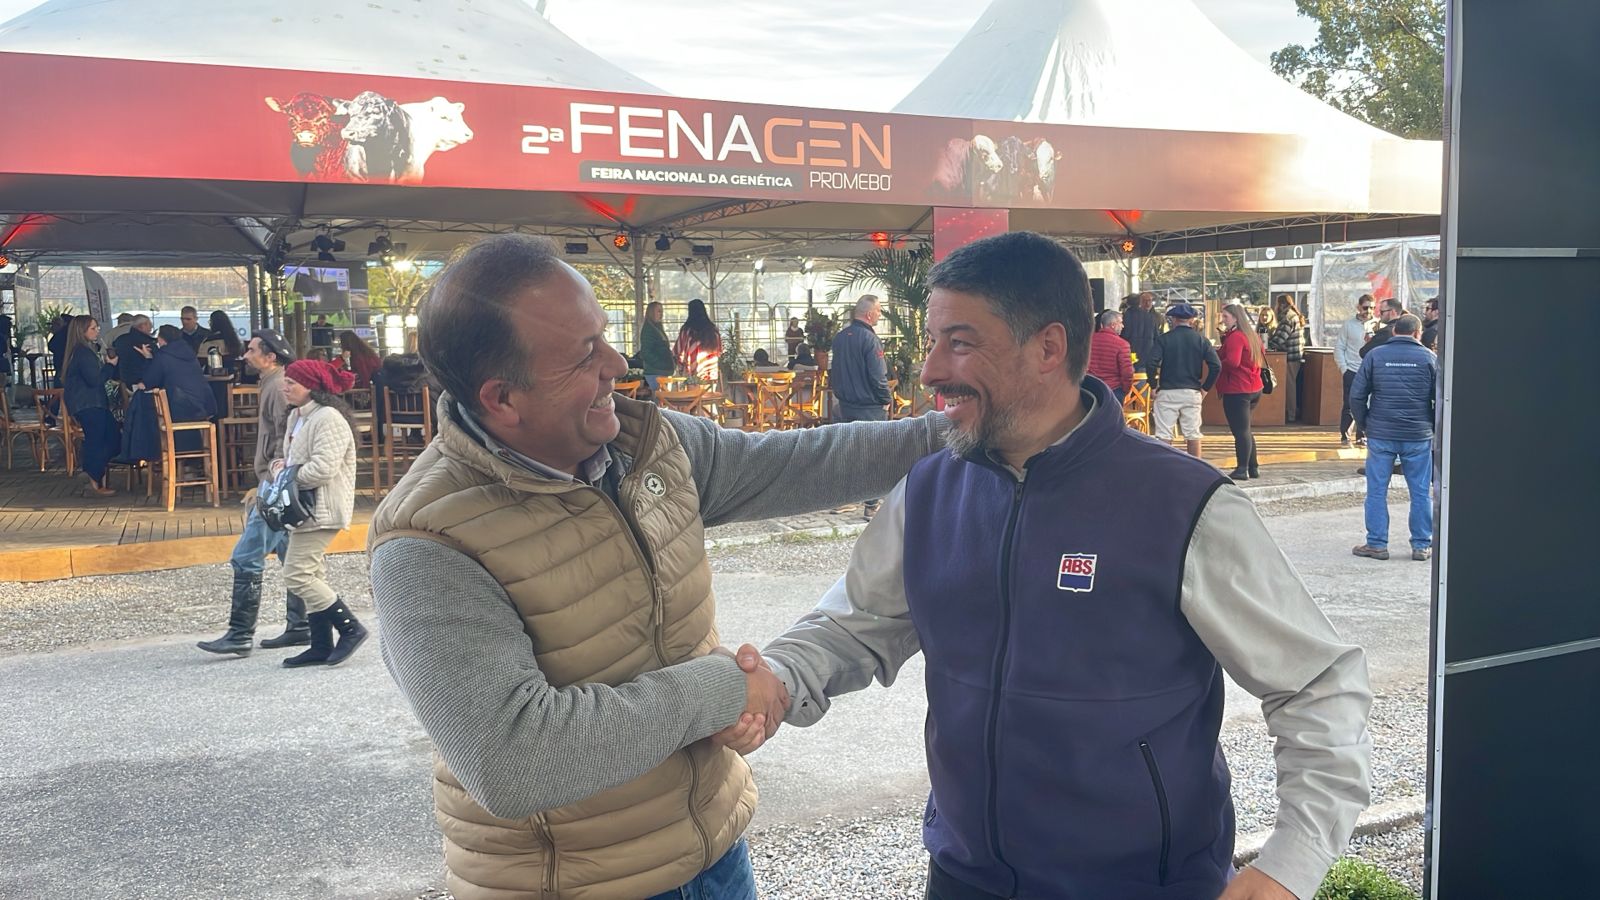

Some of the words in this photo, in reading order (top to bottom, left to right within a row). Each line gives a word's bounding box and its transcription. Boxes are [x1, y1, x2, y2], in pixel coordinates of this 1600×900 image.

[569, 102, 892, 170] FENAGEN
[591, 167, 633, 181] FEIRA
[635, 169, 706, 184] NACIONAL
[708, 173, 727, 185] DA
[730, 173, 793, 188] GENÉTICA
[809, 171, 891, 191] PROMEBO
[1061, 559, 1093, 575] ABS
